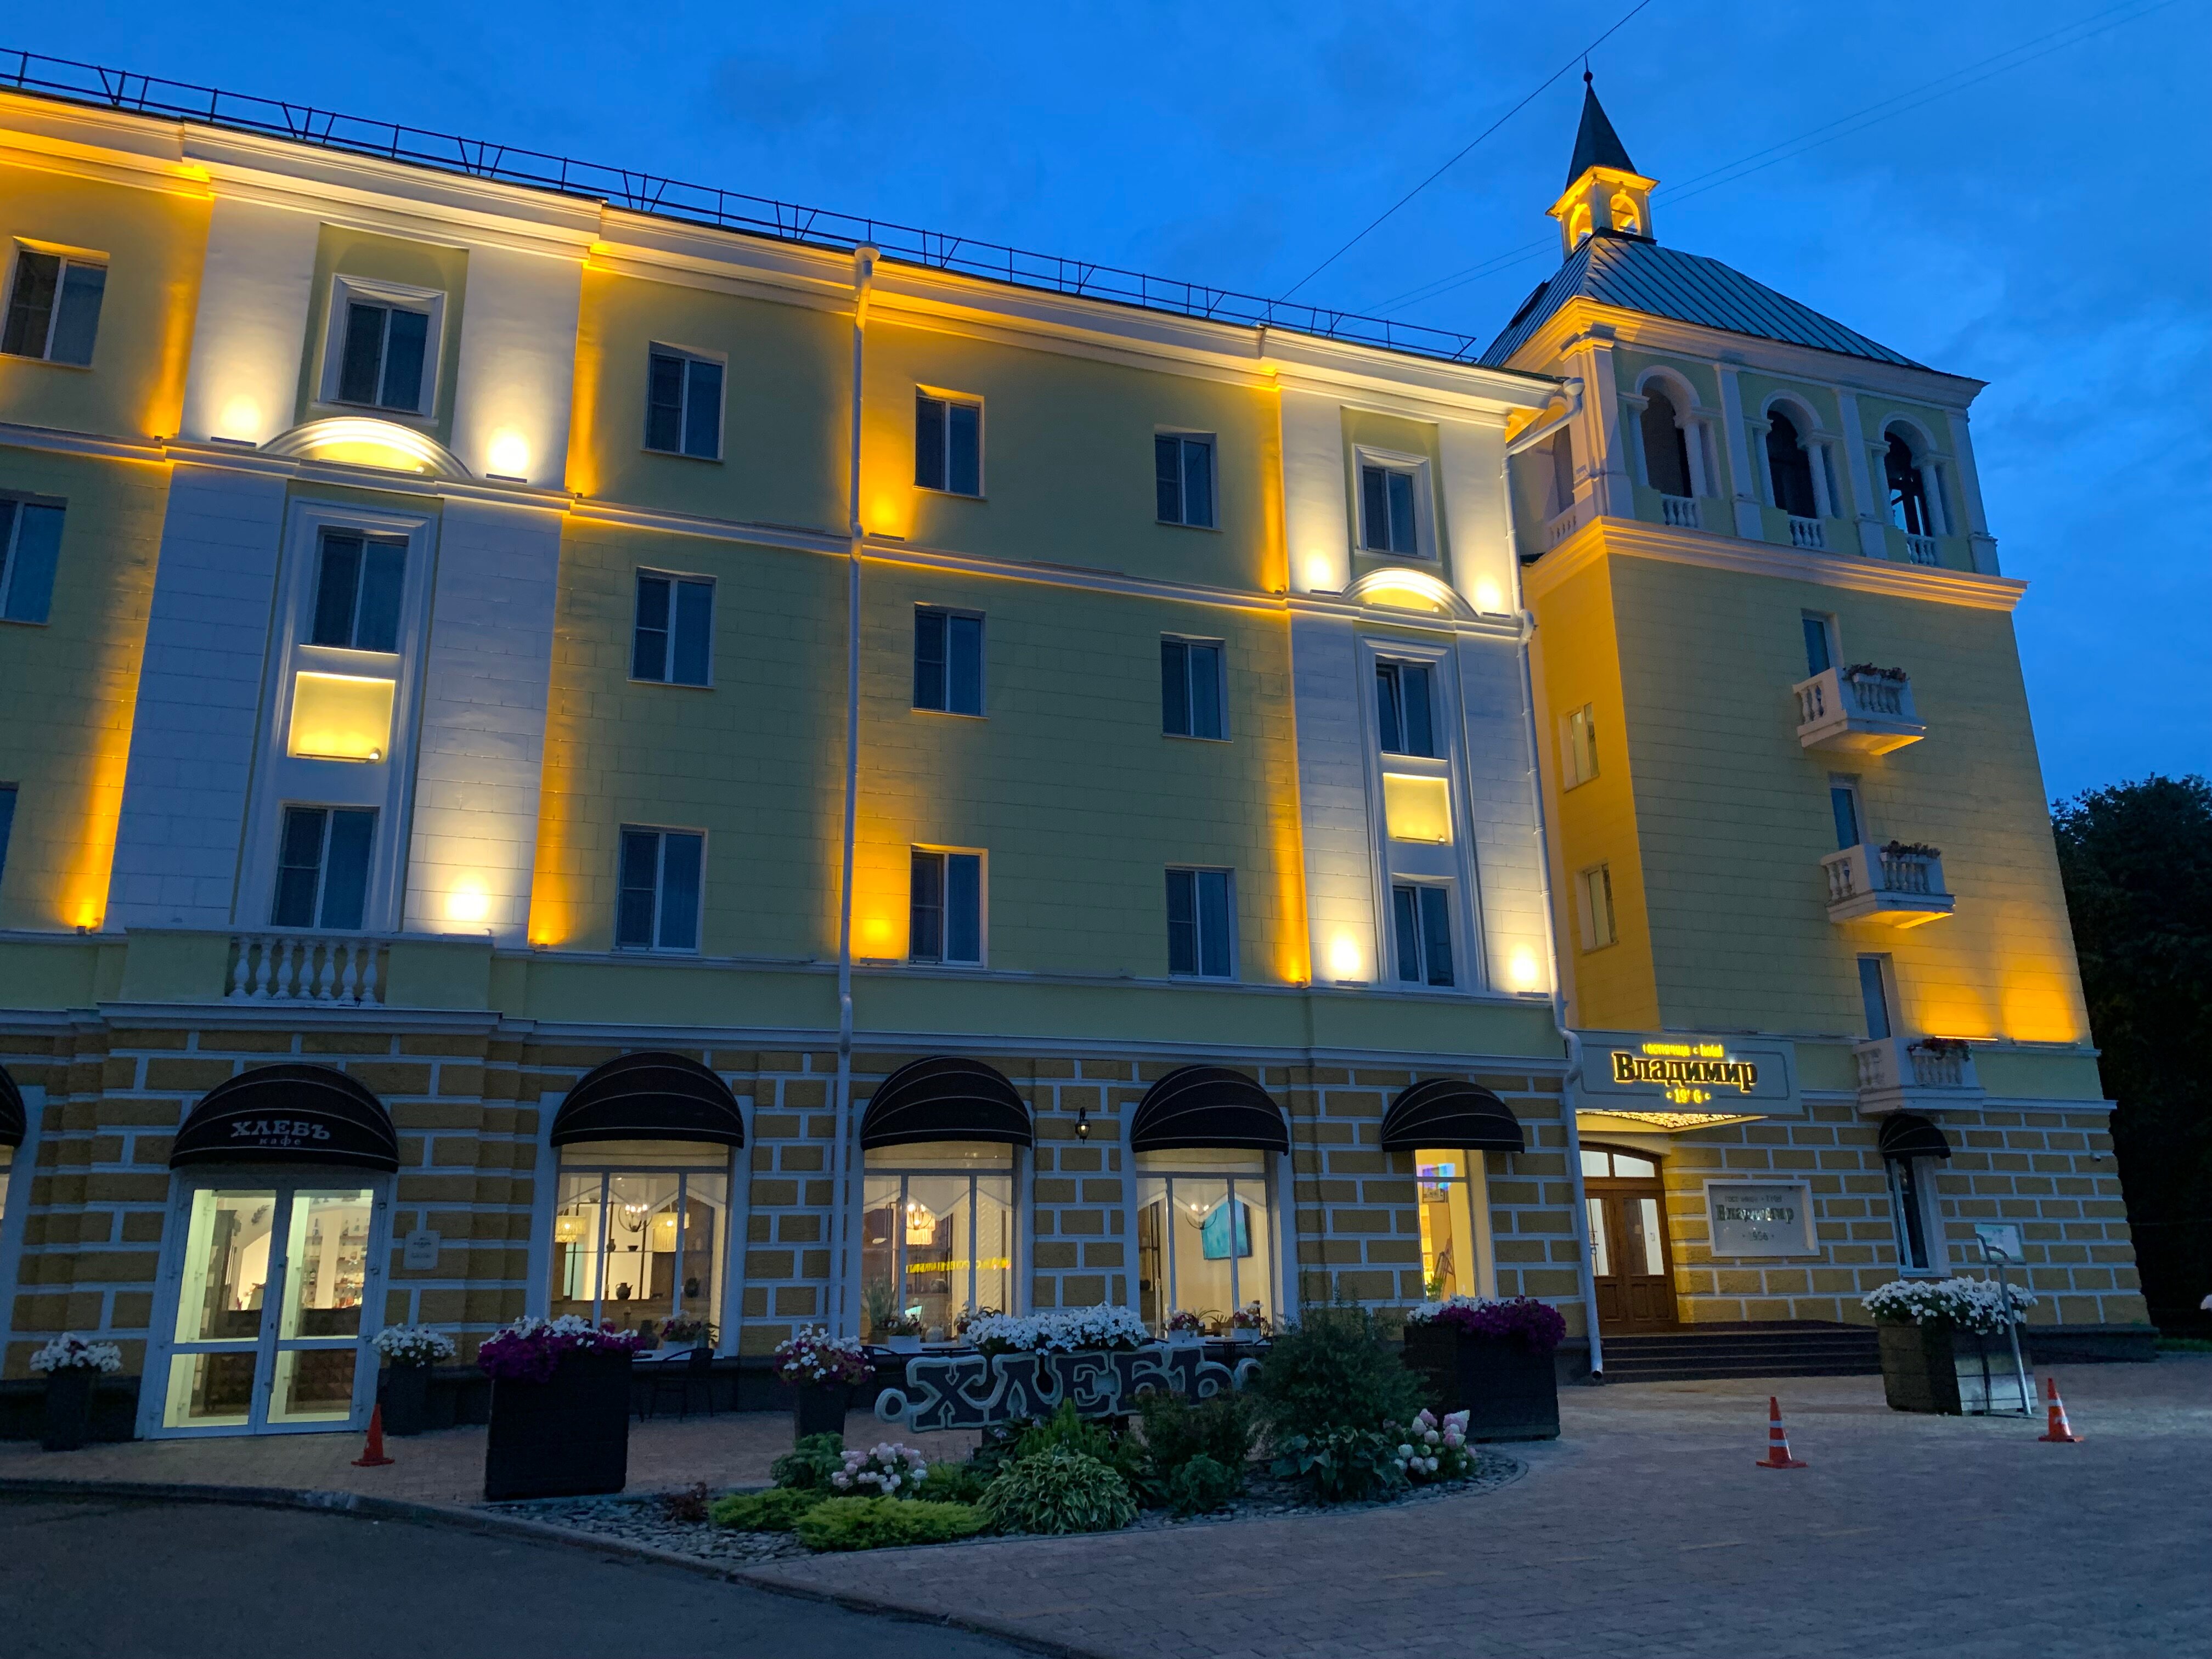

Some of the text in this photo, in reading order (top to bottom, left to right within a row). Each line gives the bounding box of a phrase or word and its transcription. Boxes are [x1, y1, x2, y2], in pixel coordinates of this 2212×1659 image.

[1611, 1051, 1758, 1093] Владимир
[230, 1120, 330, 1139] ХЛЕБЪ
[259, 1135, 302, 1147] кафе
[905, 1346, 1237, 1433] ХЛЕБЪ
